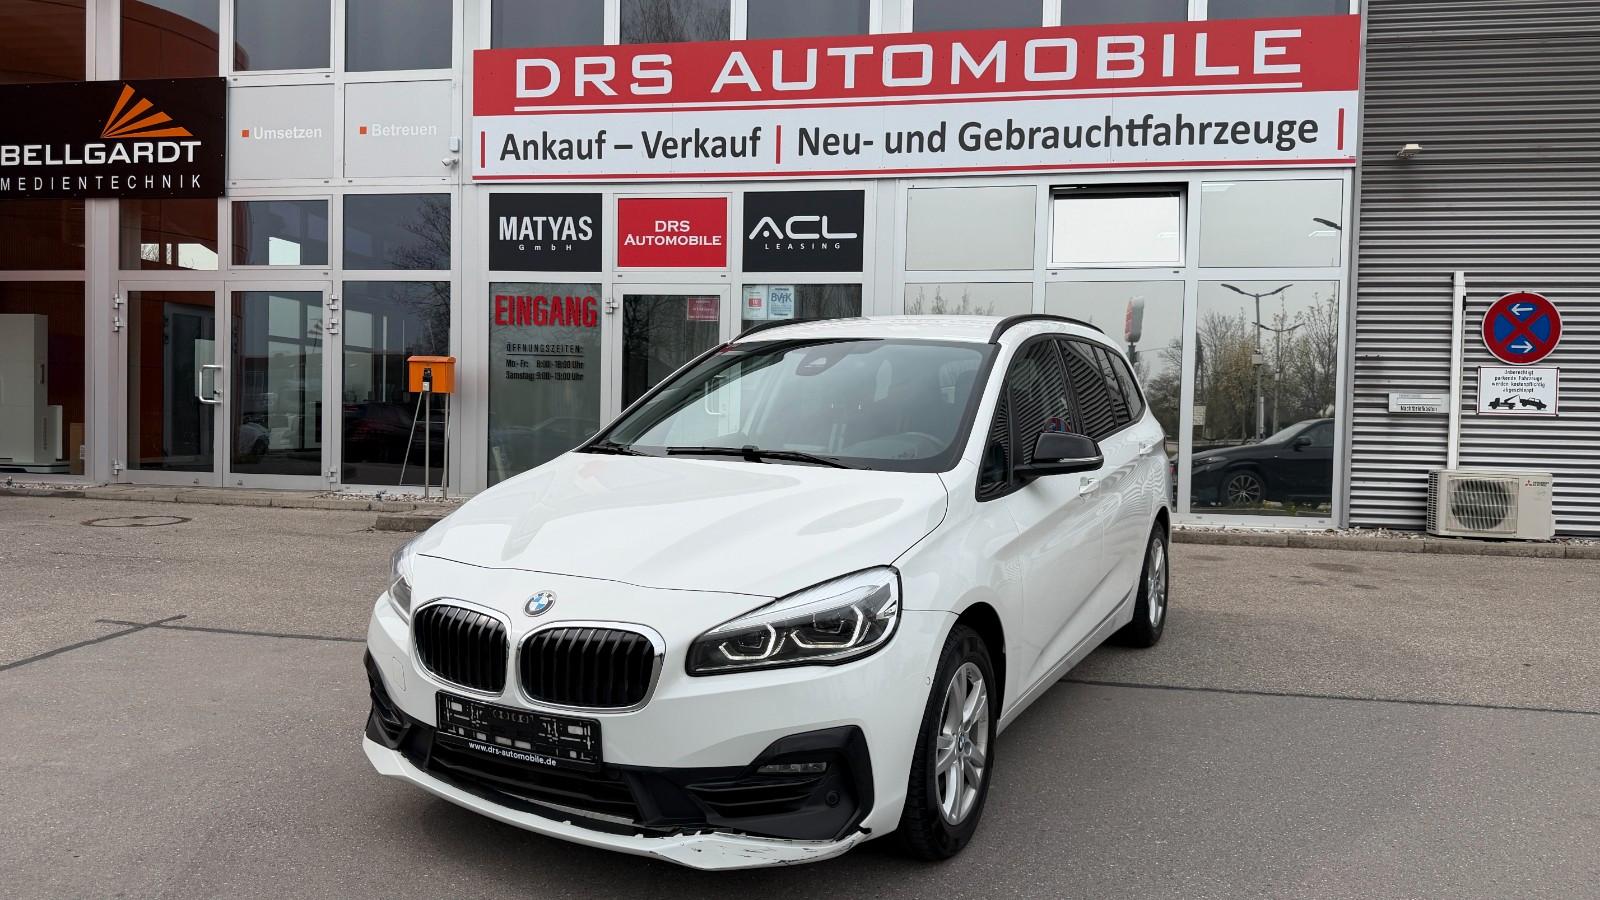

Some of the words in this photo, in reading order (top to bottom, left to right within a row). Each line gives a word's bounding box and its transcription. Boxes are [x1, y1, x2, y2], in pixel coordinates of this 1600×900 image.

[515, 54, 673, 98] DRS
[710, 29, 1301, 93] AUTOMOBILE
[253, 126, 323, 140] Umsetzen
[371, 122, 438, 137] Betreuen
[798, 127, 873, 157] Neu-
[885, 121, 946, 155] und
[958, 113, 1319, 151] Gebrauchtfahrzeuge
[0, 141, 201, 165] BELLGARDT
[499, 130, 607, 161] Ankauf
[641, 126, 762, 159] Verkauf
[0, 174, 201, 191] MEDIENTECHNIK
[499, 216, 593, 241] MATYAS
[654, 220, 690, 232] DRS
[749, 215, 857, 240] ACL
[624, 234, 722, 246] AUTOMOBILE
[495, 295, 598, 327] EINGANG
[506, 342, 584, 353] ÖFFNUNGSZEITEN:
[469, 742, 556, 766] www.drs-automobile.de
